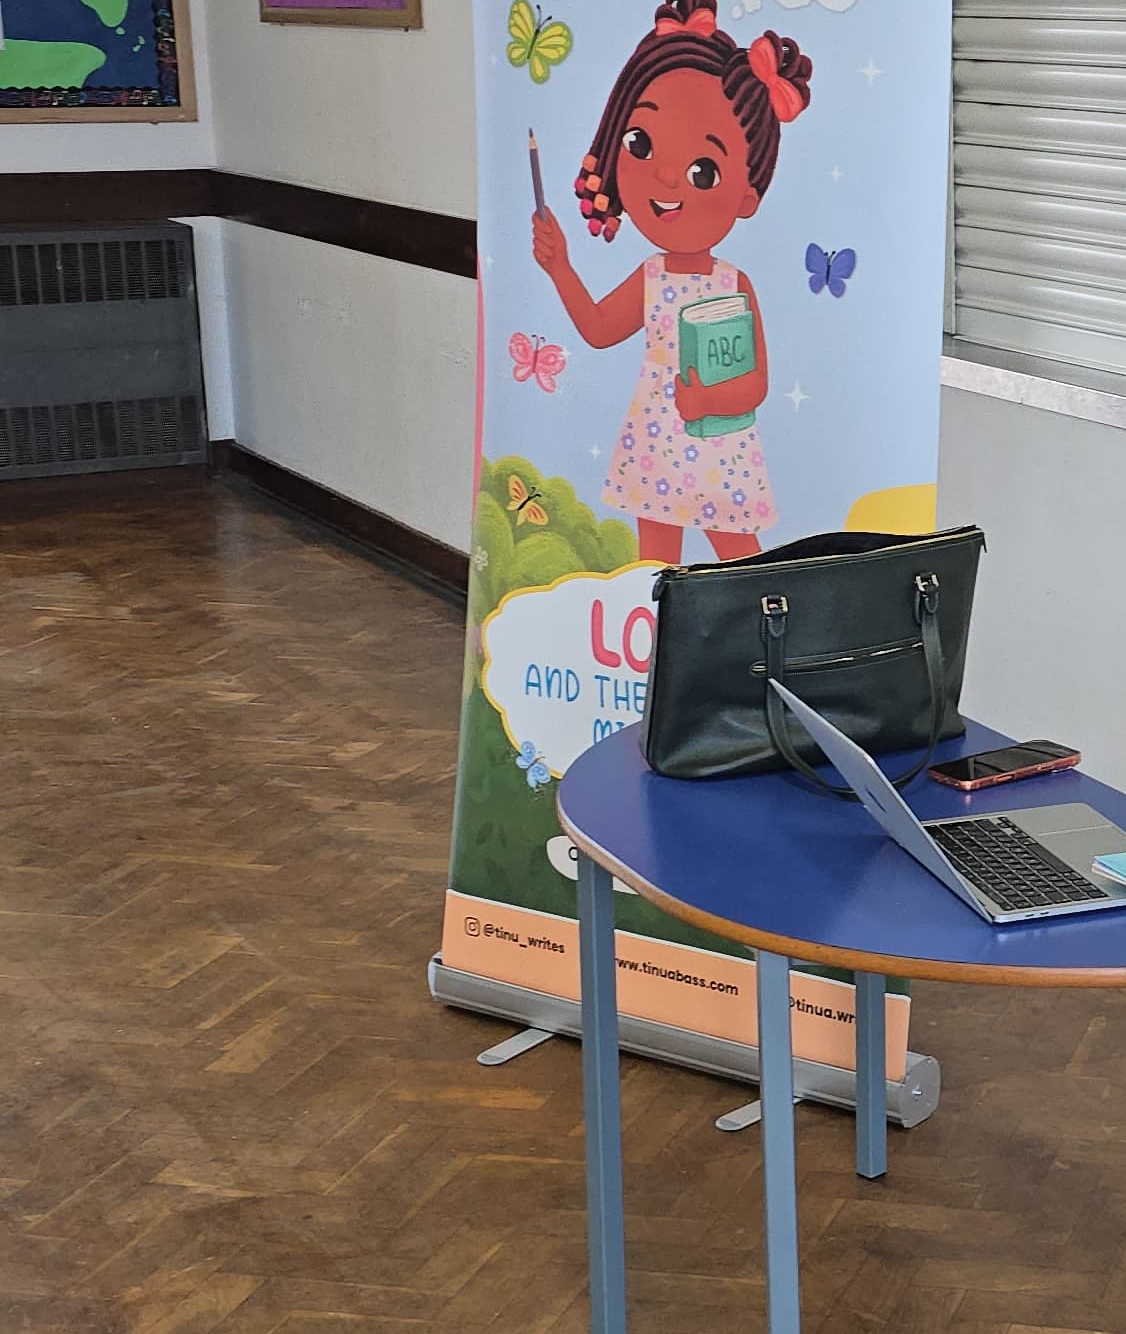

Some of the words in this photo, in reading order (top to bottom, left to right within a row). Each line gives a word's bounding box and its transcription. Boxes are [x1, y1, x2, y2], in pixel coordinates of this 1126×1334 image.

[707, 334, 746, 367] ABC
[594, 674, 648, 714] THE
[483, 923, 565, 954] @tinu_writes
